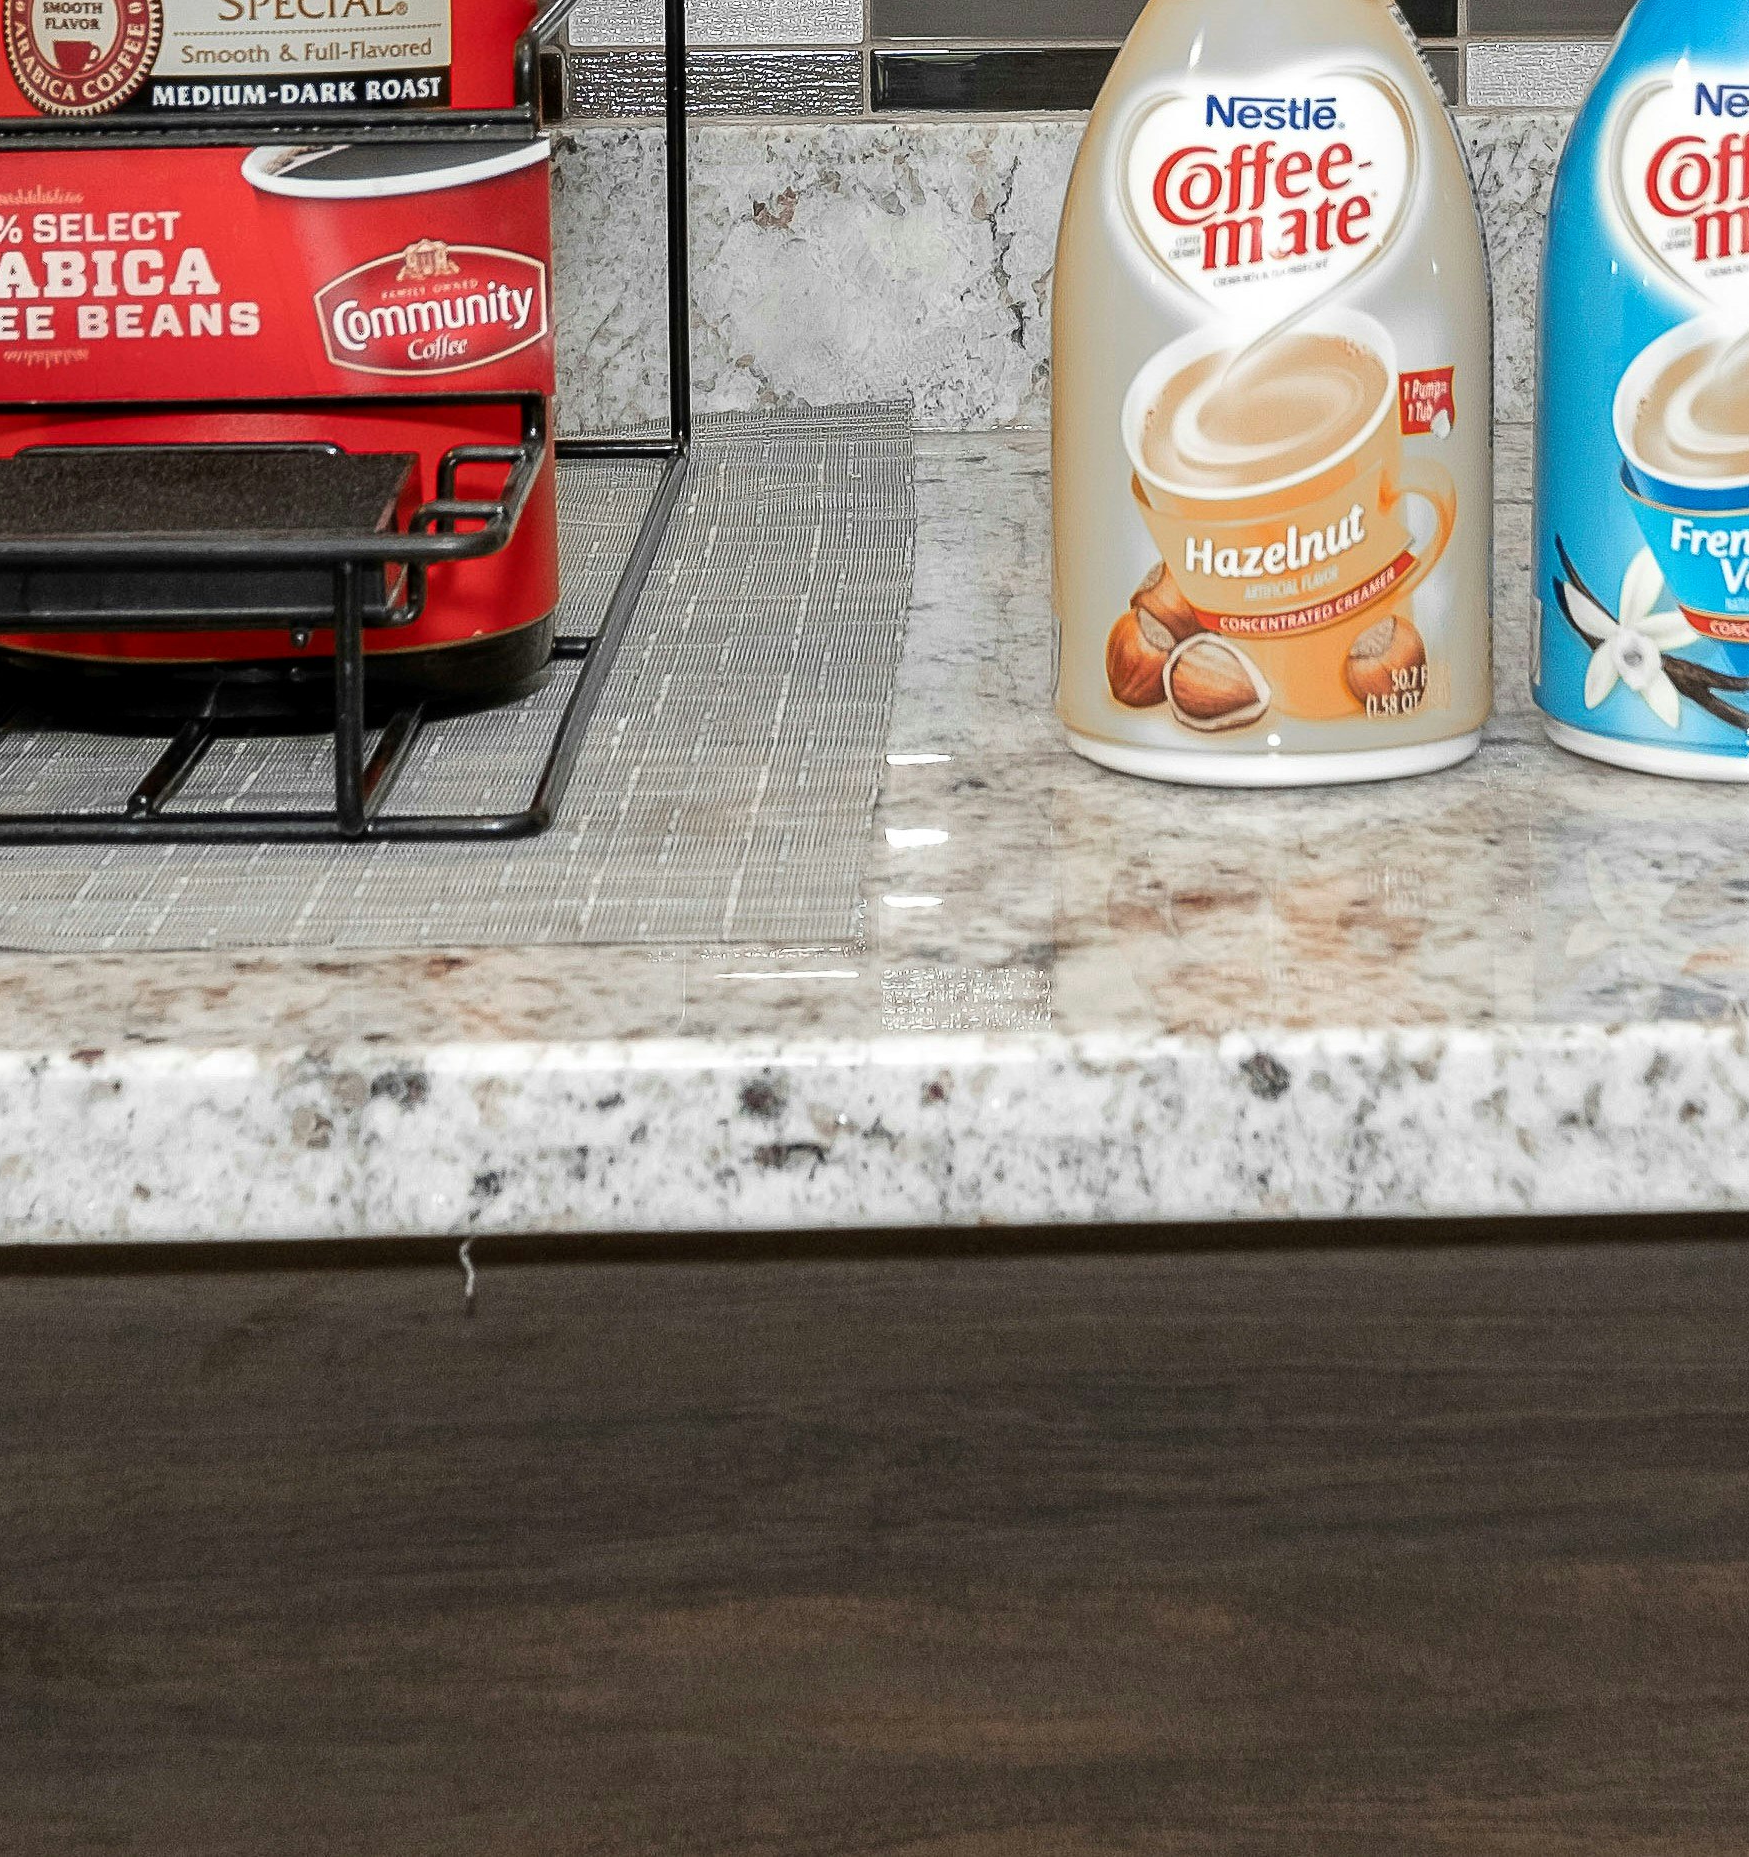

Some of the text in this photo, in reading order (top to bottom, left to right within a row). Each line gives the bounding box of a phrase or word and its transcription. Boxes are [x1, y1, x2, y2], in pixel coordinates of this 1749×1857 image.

[43, 2, 103, 13] SMOOTH
[45, 18, 100, 30] FLAVOR
[15, 22, 145, 101] ARABICA COFFEE
[181, 39, 432, 65] Smooth & Full-Flavored
[152, 77, 441, 106] MEDIUM-DARK ROAST
[1205, 94, 1337, 130] Nestlé
[32, 210, 182, 242] SELECT
[1201, 188, 1373, 271] mate
[78, 302, 261, 339] BEANS
[333, 281, 533, 351] Community
[407, 332, 468, 362] Coffee
[1185, 504, 1366, 579] Hazelnut
[1219, 566, 1395, 632] CONCENTRATED CREAMER
